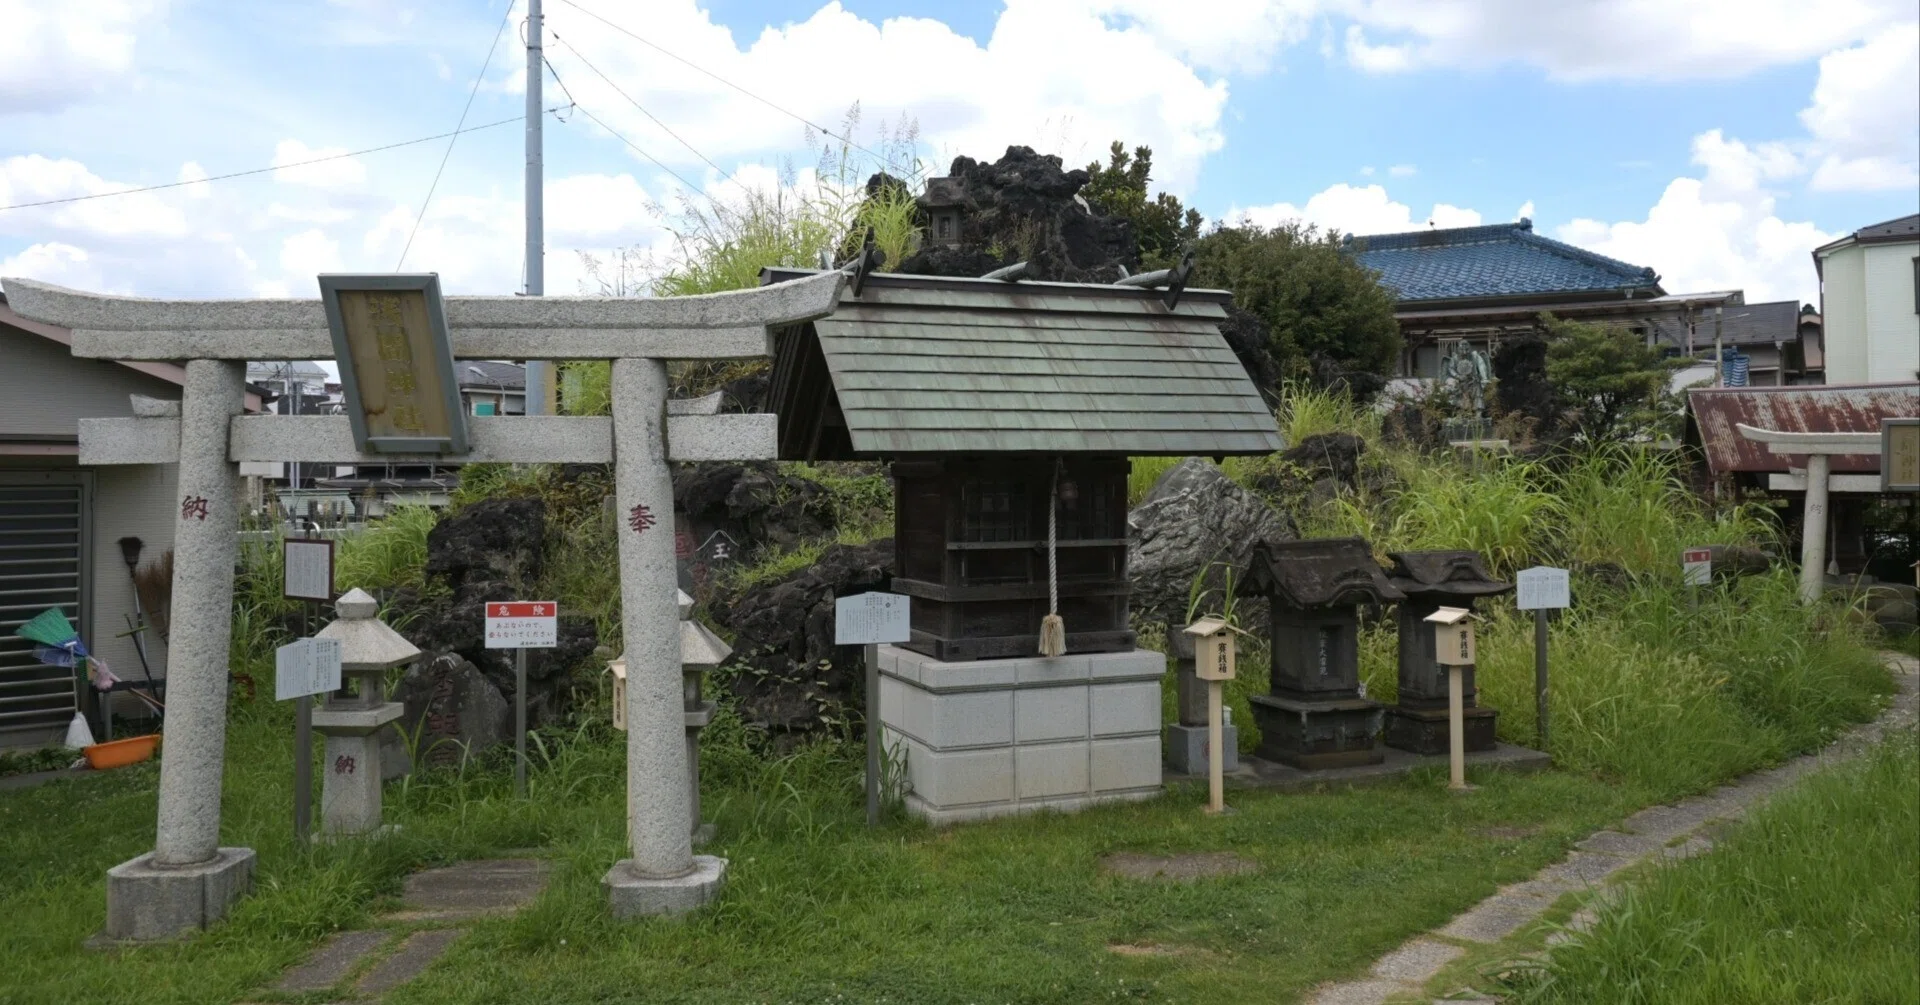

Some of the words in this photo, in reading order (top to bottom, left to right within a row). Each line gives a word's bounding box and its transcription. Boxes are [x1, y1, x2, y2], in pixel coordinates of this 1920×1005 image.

[182, 495, 209, 521] 納
[628, 504, 656, 534] 奉
[498, 605, 545, 616] 危険
[1218, 643, 1227, 674] 賽銭箱
[335, 755, 356, 775] 納
